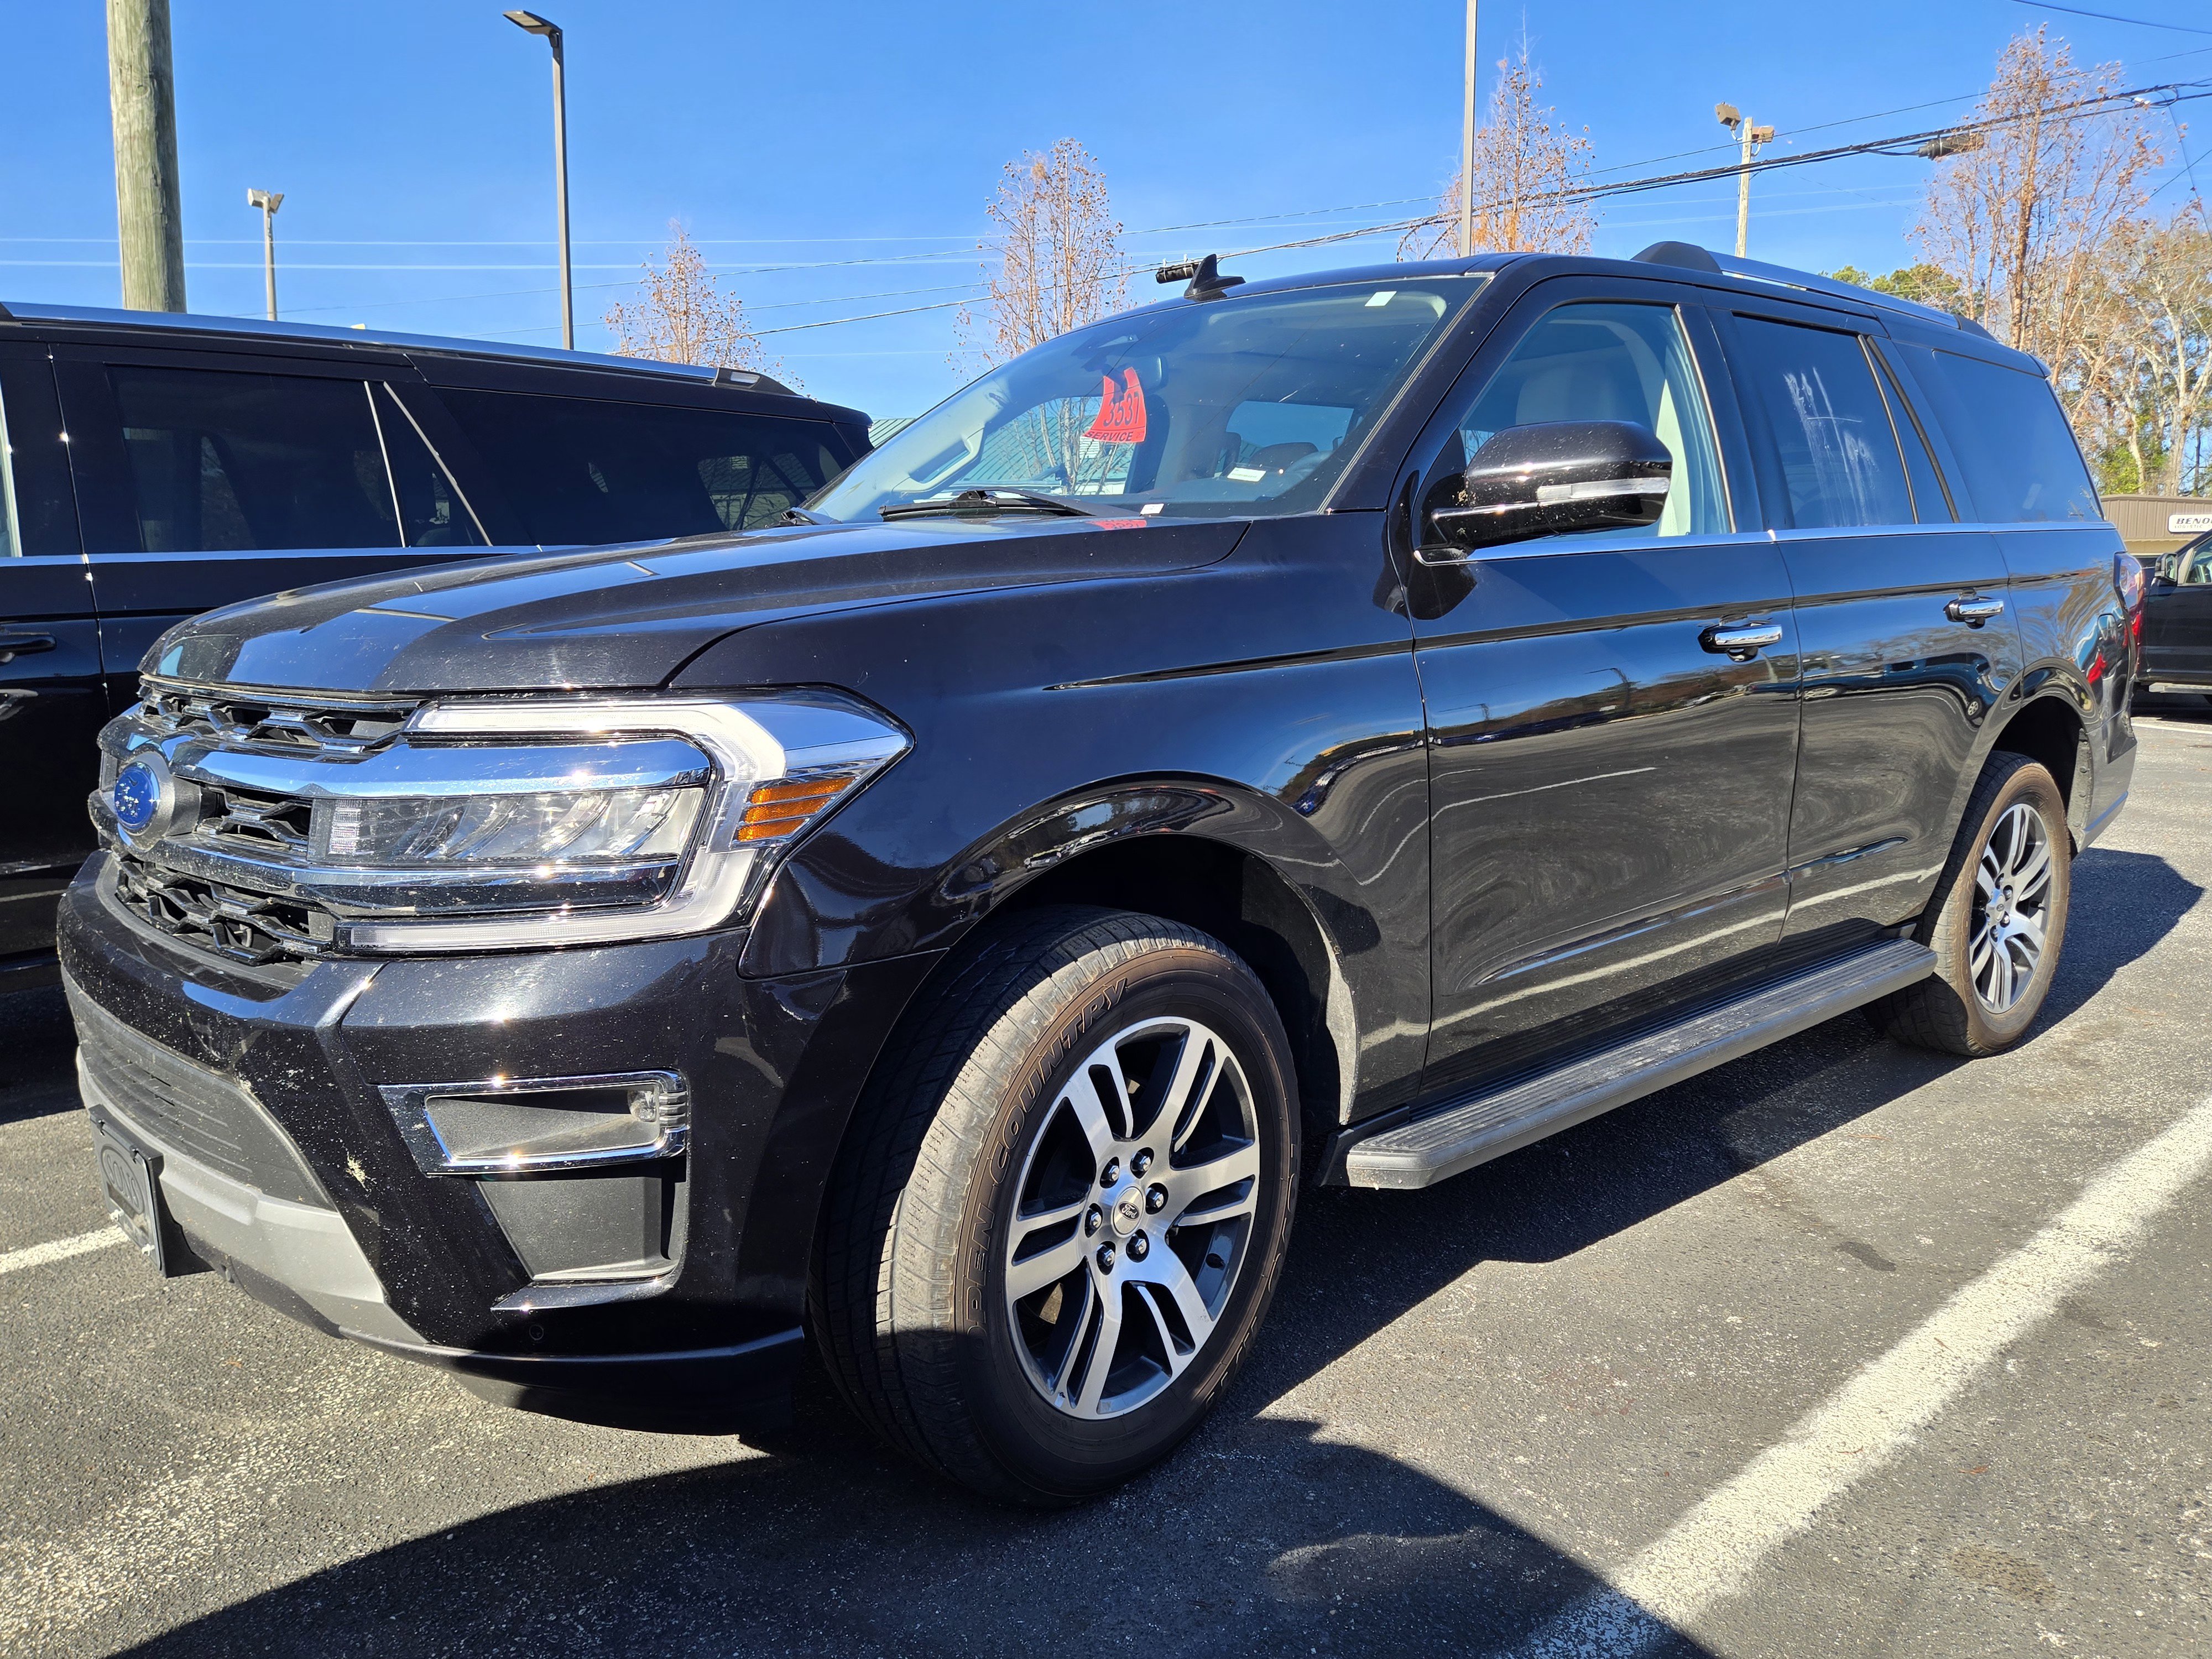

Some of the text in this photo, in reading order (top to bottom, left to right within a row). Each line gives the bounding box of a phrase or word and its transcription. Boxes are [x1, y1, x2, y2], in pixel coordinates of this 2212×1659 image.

[1085, 430, 1134, 442] SERVICE
[989, 977, 1128, 1185] COUNTRY
[1121, 1204, 1138, 1219] Ford
